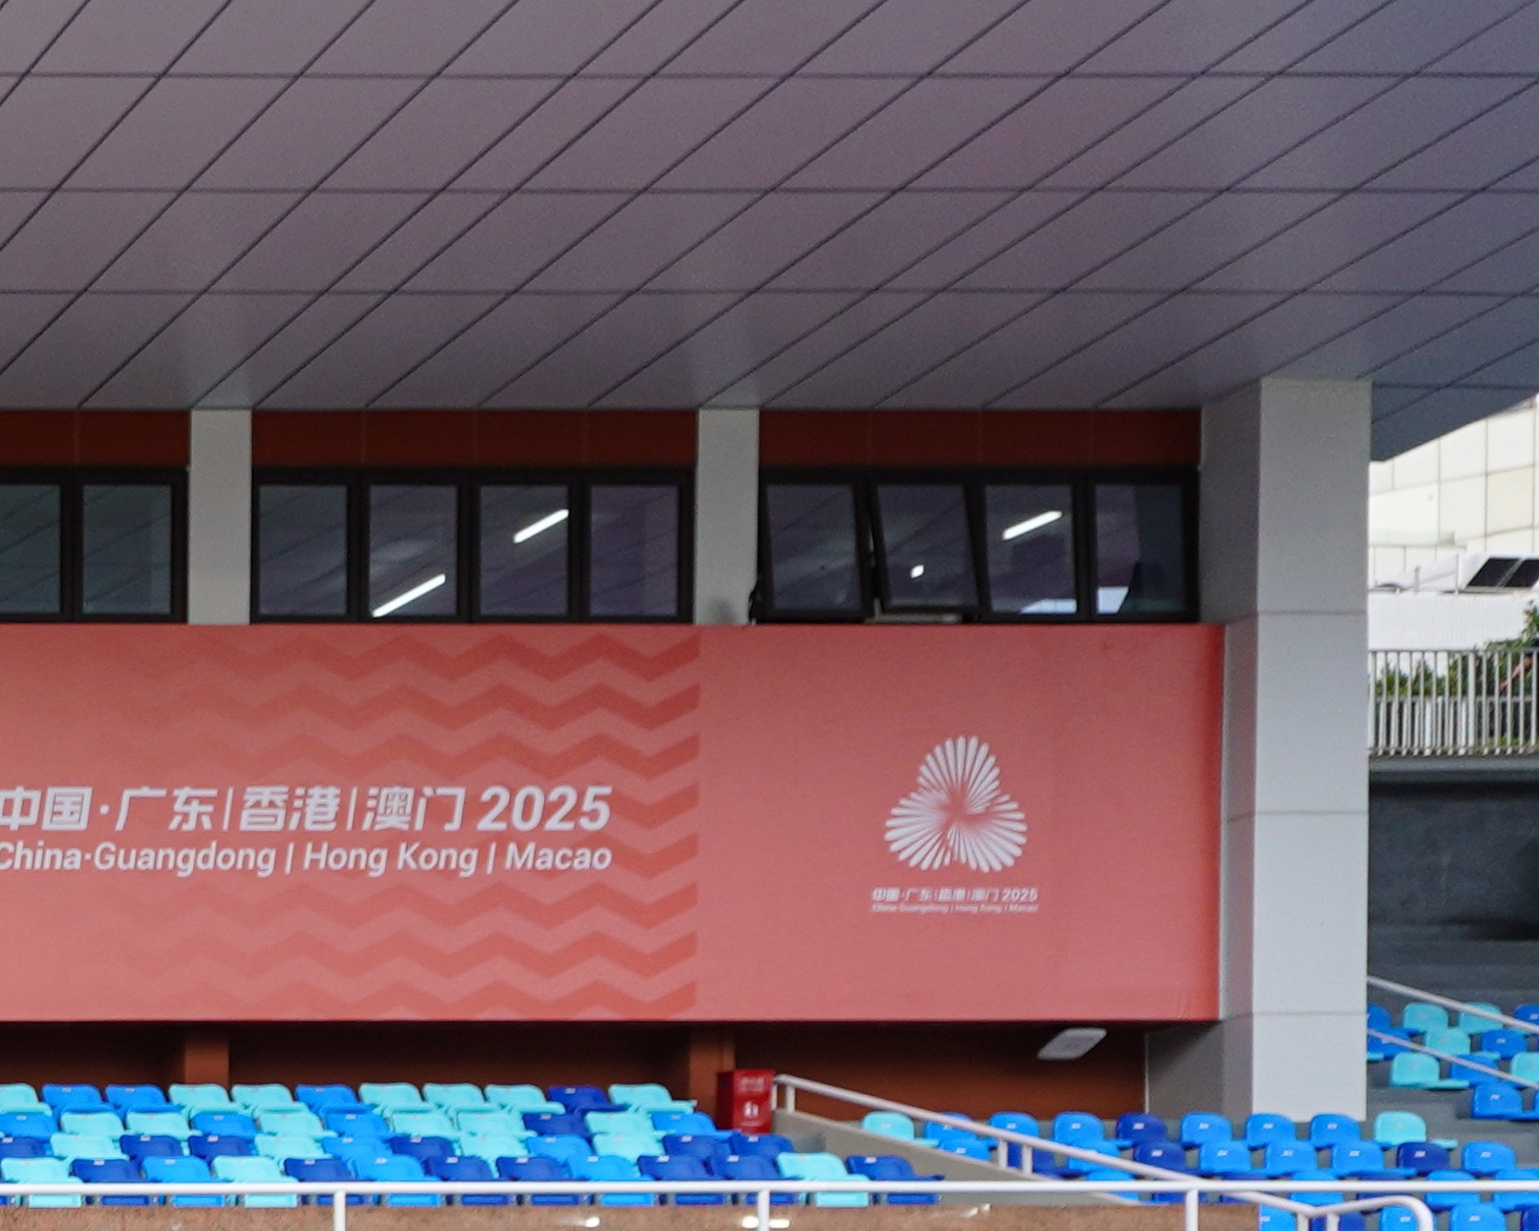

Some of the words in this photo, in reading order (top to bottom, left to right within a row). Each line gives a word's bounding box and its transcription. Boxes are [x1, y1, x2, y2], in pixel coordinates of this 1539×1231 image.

[477, 785, 612, 831] 2025
[303, 842, 388, 878] Hong
[397, 842, 478, 878] Kong
[505, 842, 612, 871] Macao
